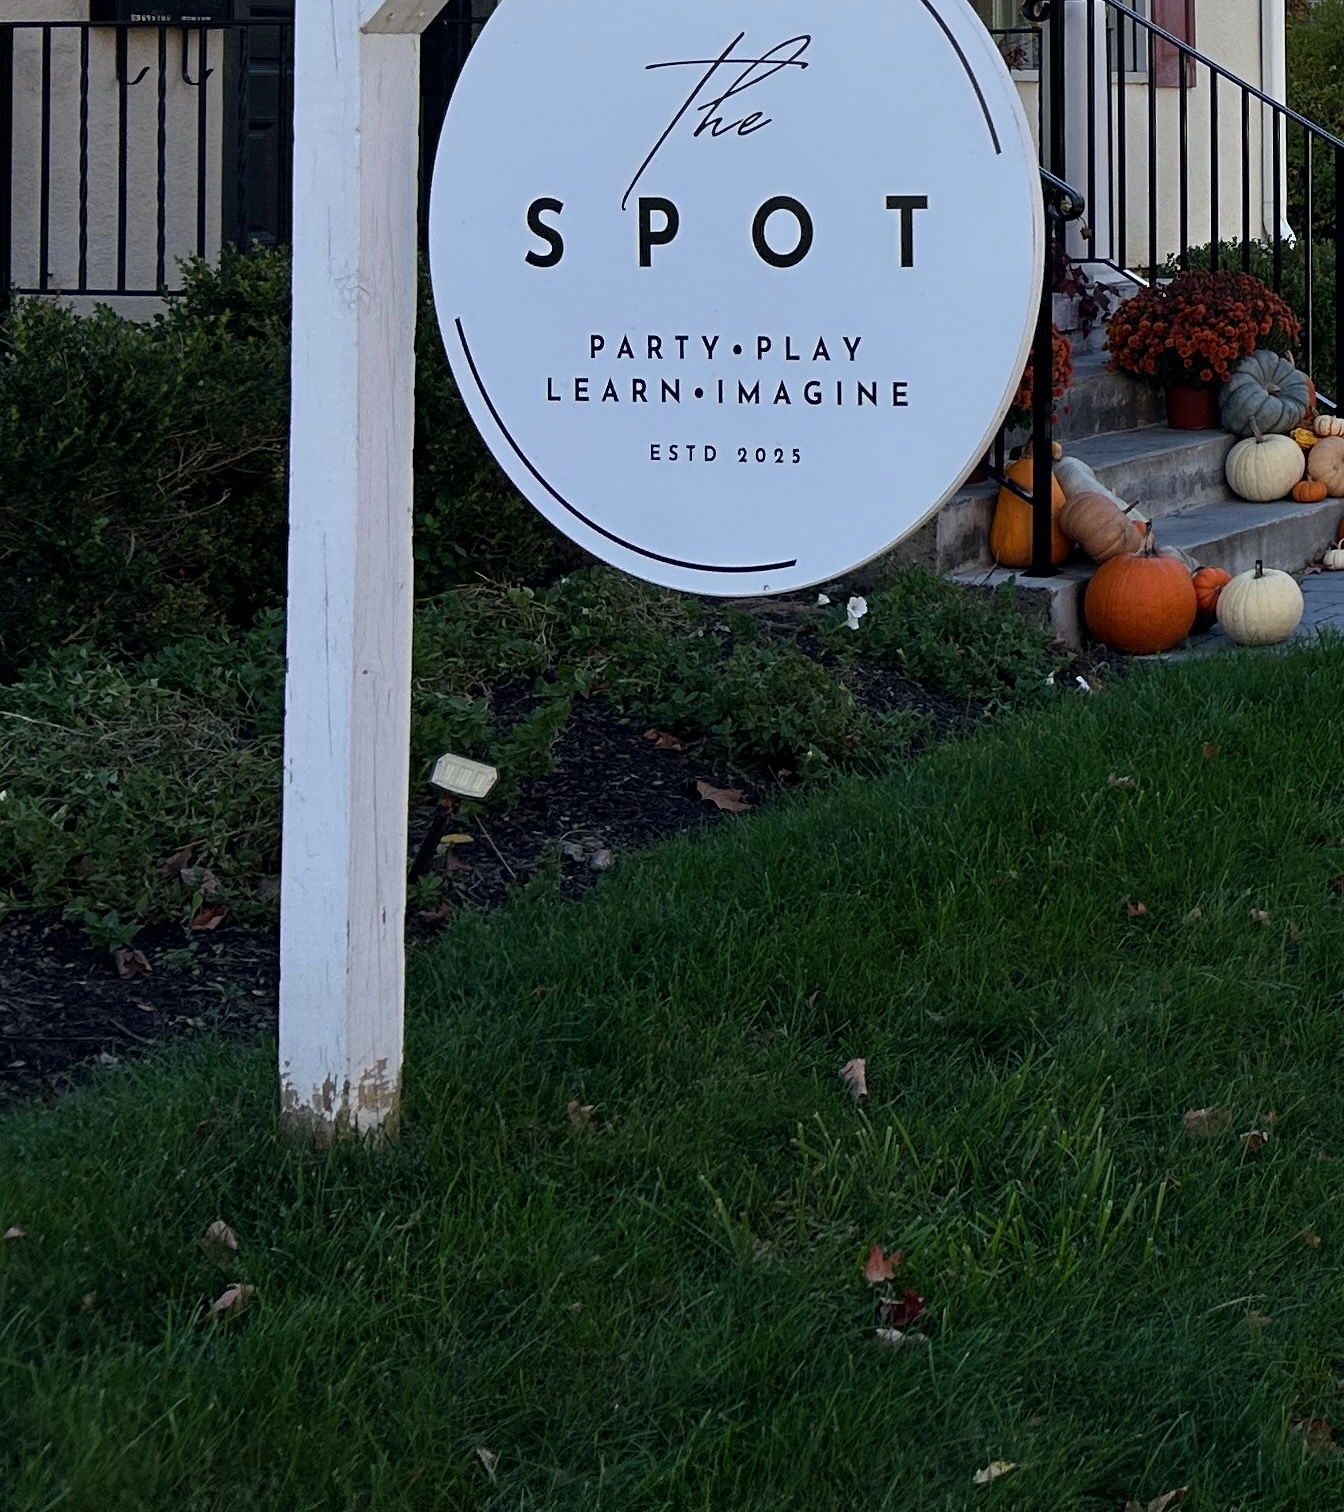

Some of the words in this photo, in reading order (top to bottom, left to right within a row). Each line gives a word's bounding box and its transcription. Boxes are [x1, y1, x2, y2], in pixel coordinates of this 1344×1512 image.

[524, 194, 929, 269] SPOT
[650, 443, 718, 462] ESTD
[737, 446, 801, 464] 2025
